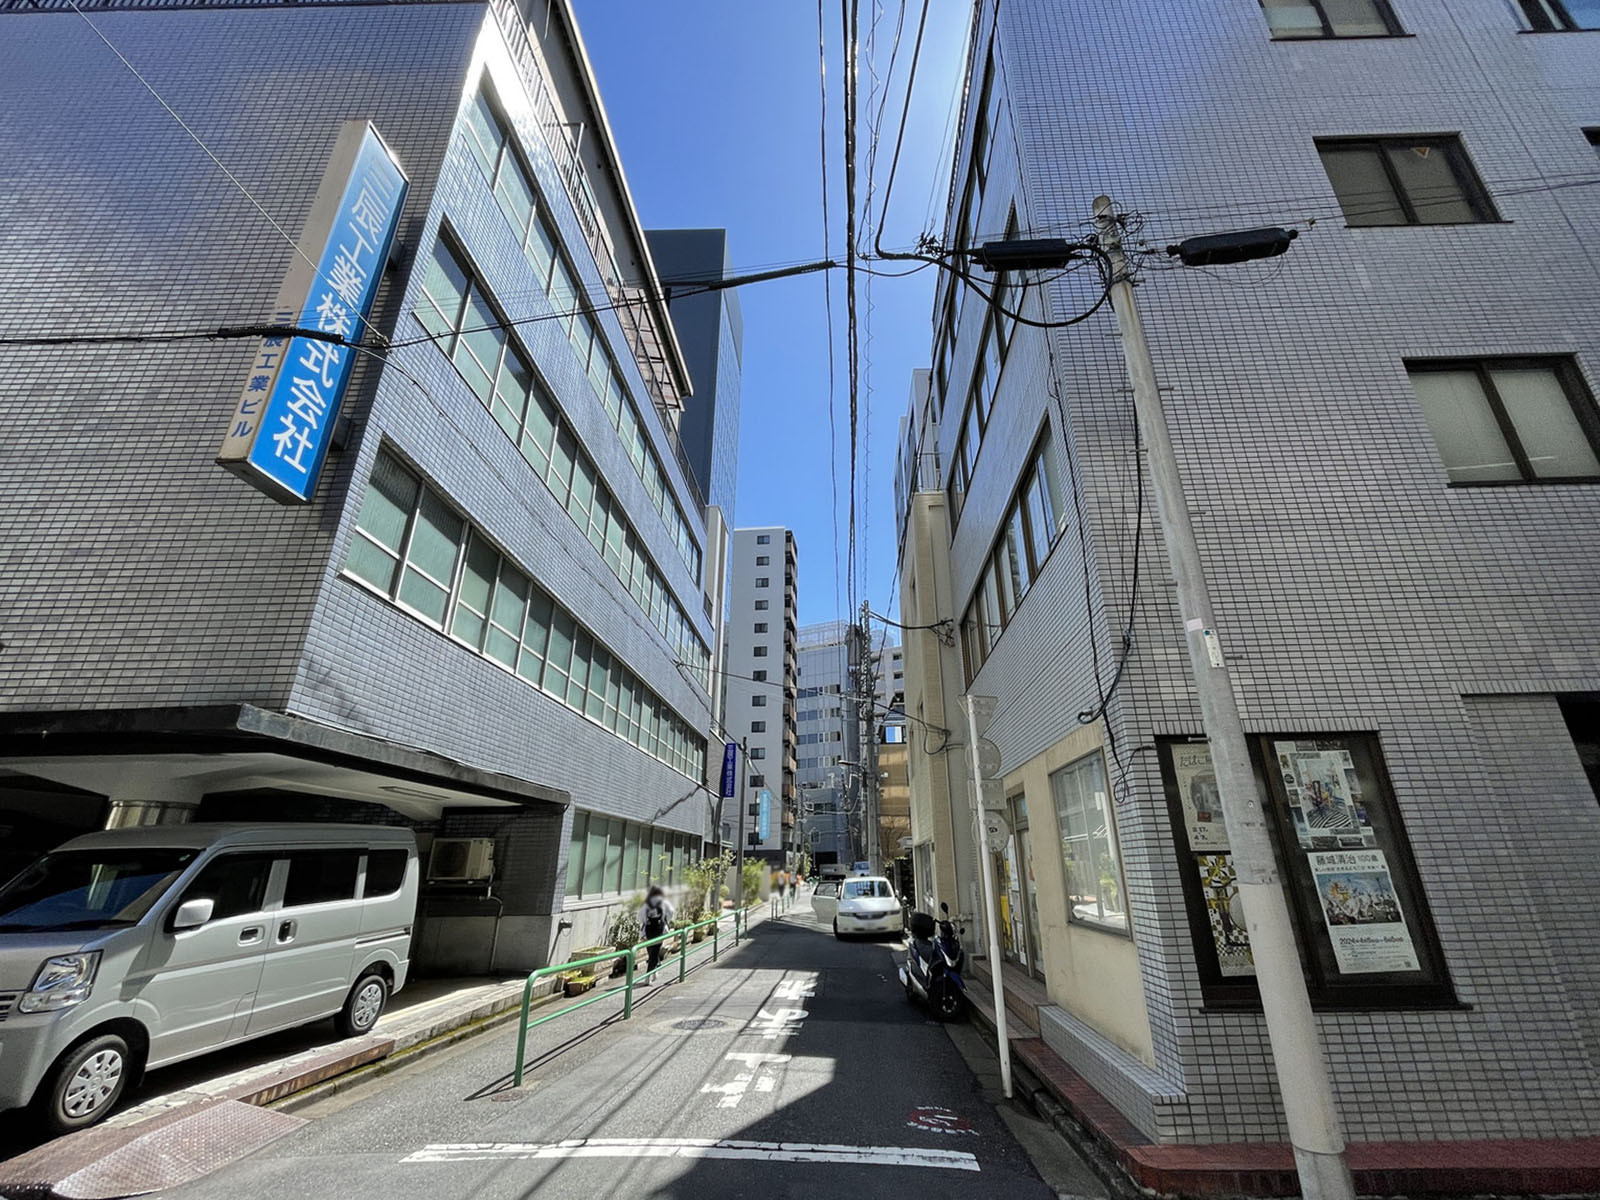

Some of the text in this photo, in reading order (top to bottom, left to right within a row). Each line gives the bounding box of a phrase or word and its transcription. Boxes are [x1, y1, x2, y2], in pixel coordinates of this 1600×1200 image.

[273, 166, 394, 474] 三辰工業株式会社
